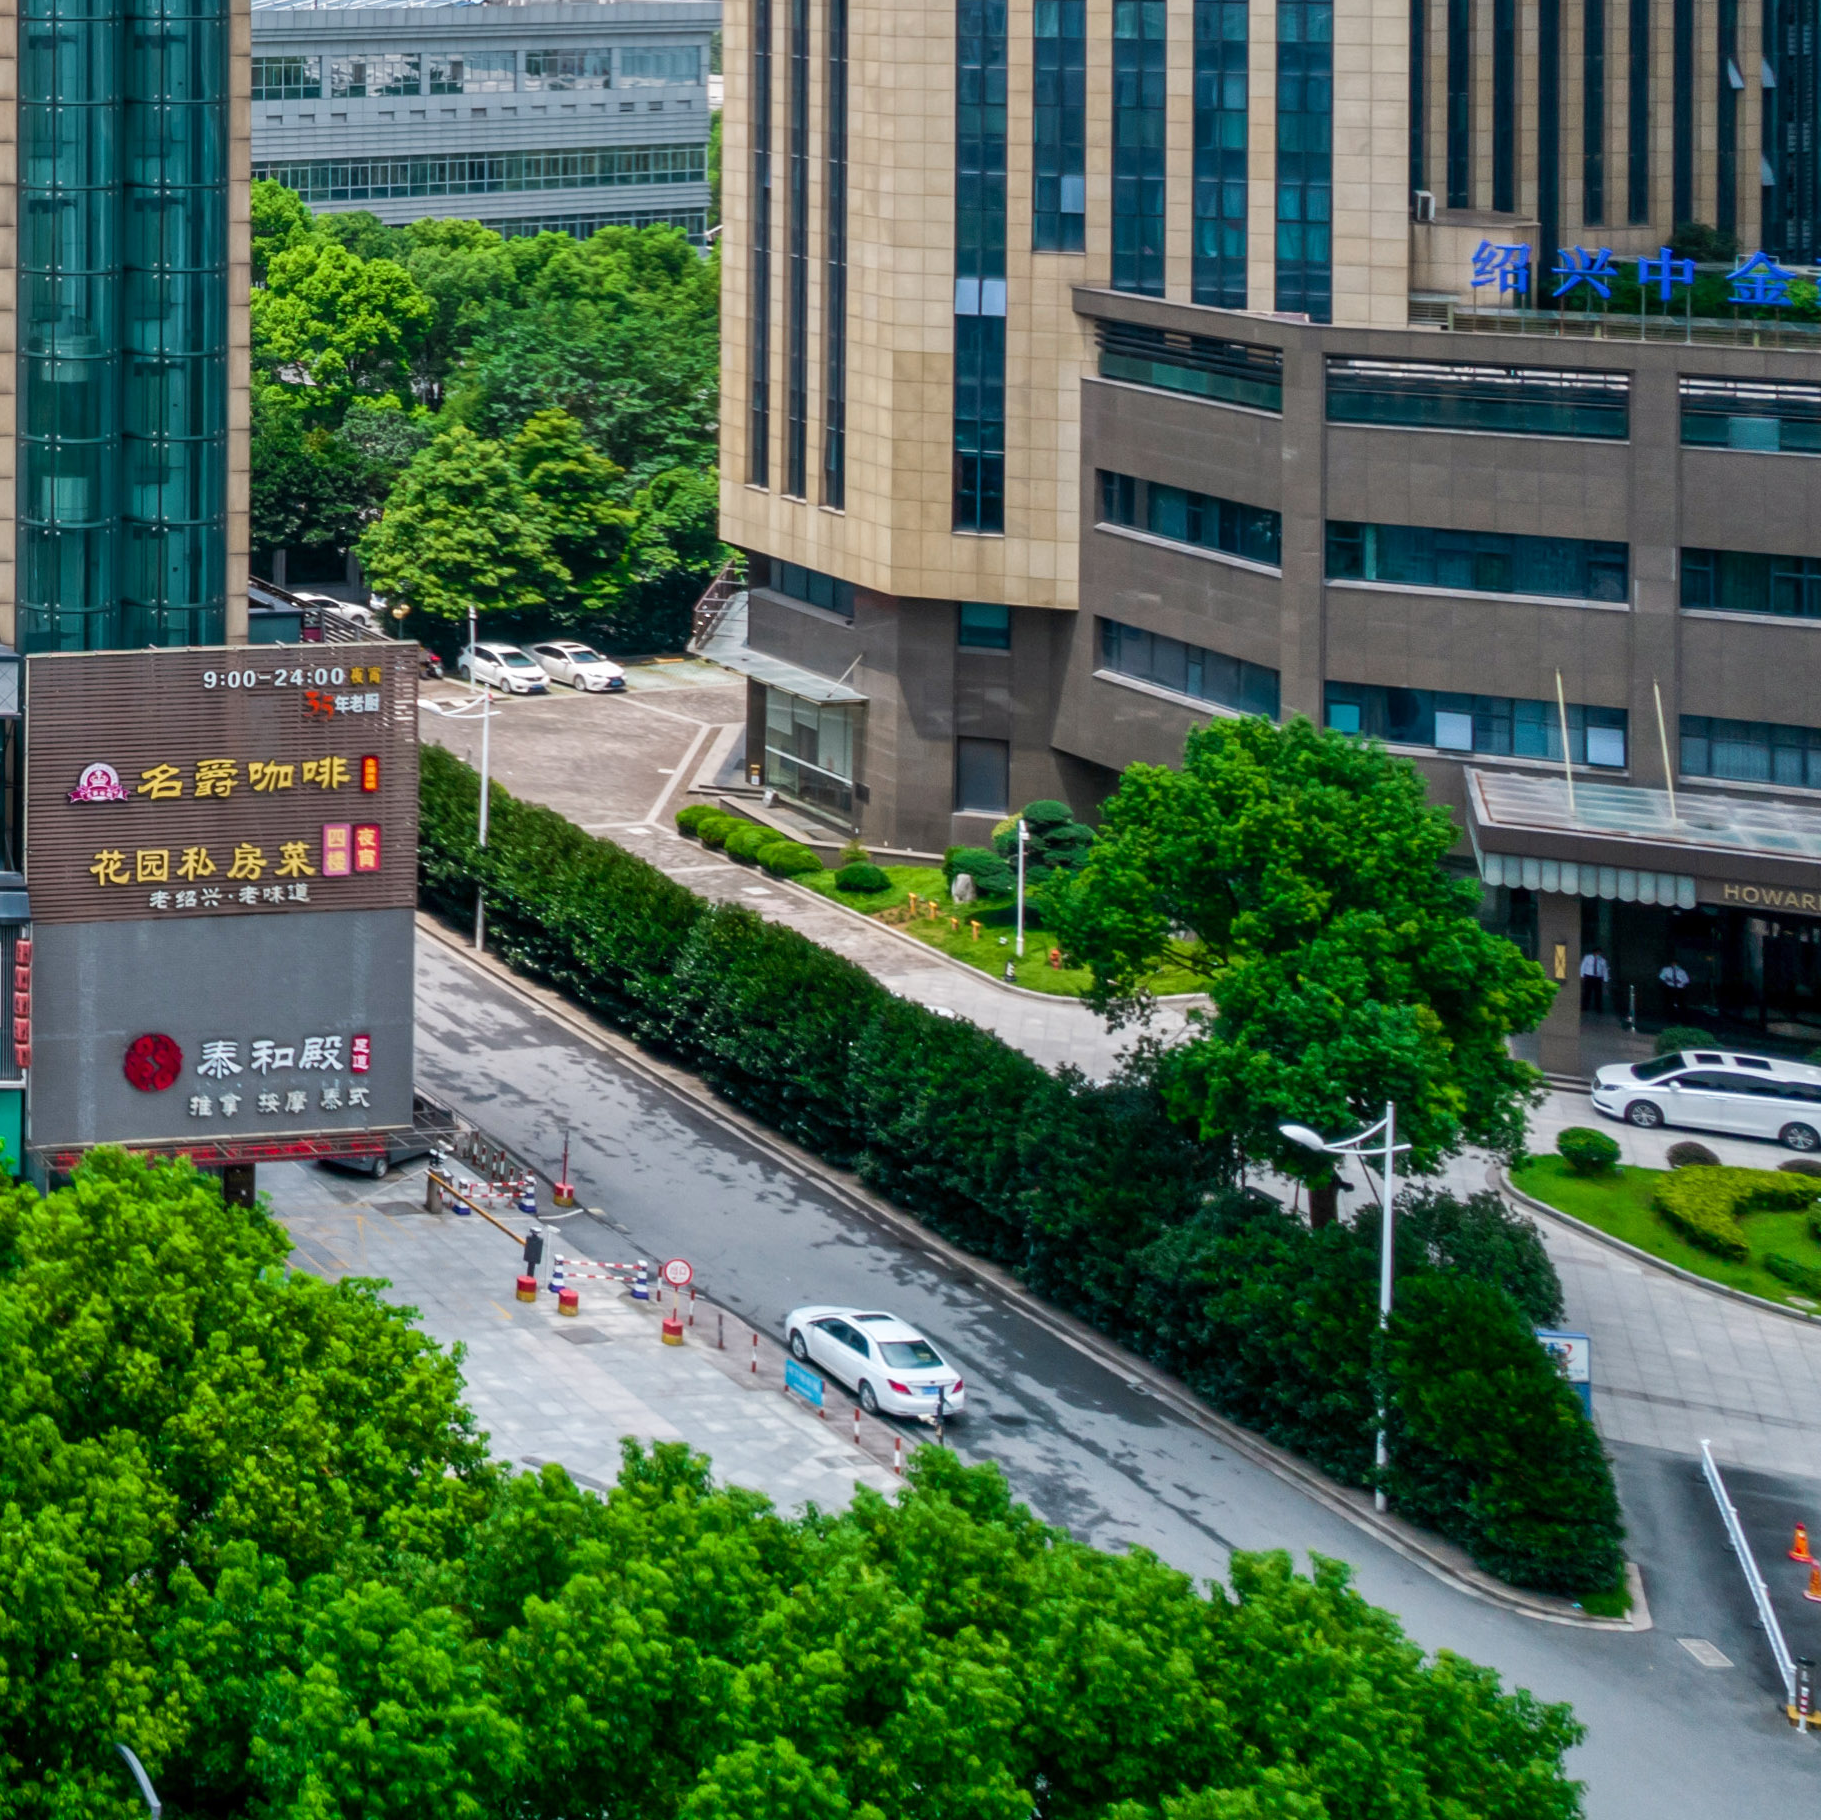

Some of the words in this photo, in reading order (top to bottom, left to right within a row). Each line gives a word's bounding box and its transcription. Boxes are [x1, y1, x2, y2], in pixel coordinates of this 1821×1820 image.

[1470, 238, 1821, 307] 绍兴中金
[137, 755, 351, 800] 名爵咖啡
[89, 840, 317, 886] 花园私房菜
[357, 827, 377, 869] 夜宵
[1723, 883, 1821, 911] HOWAR
[196, 1035, 345, 1079] 泰和殿
